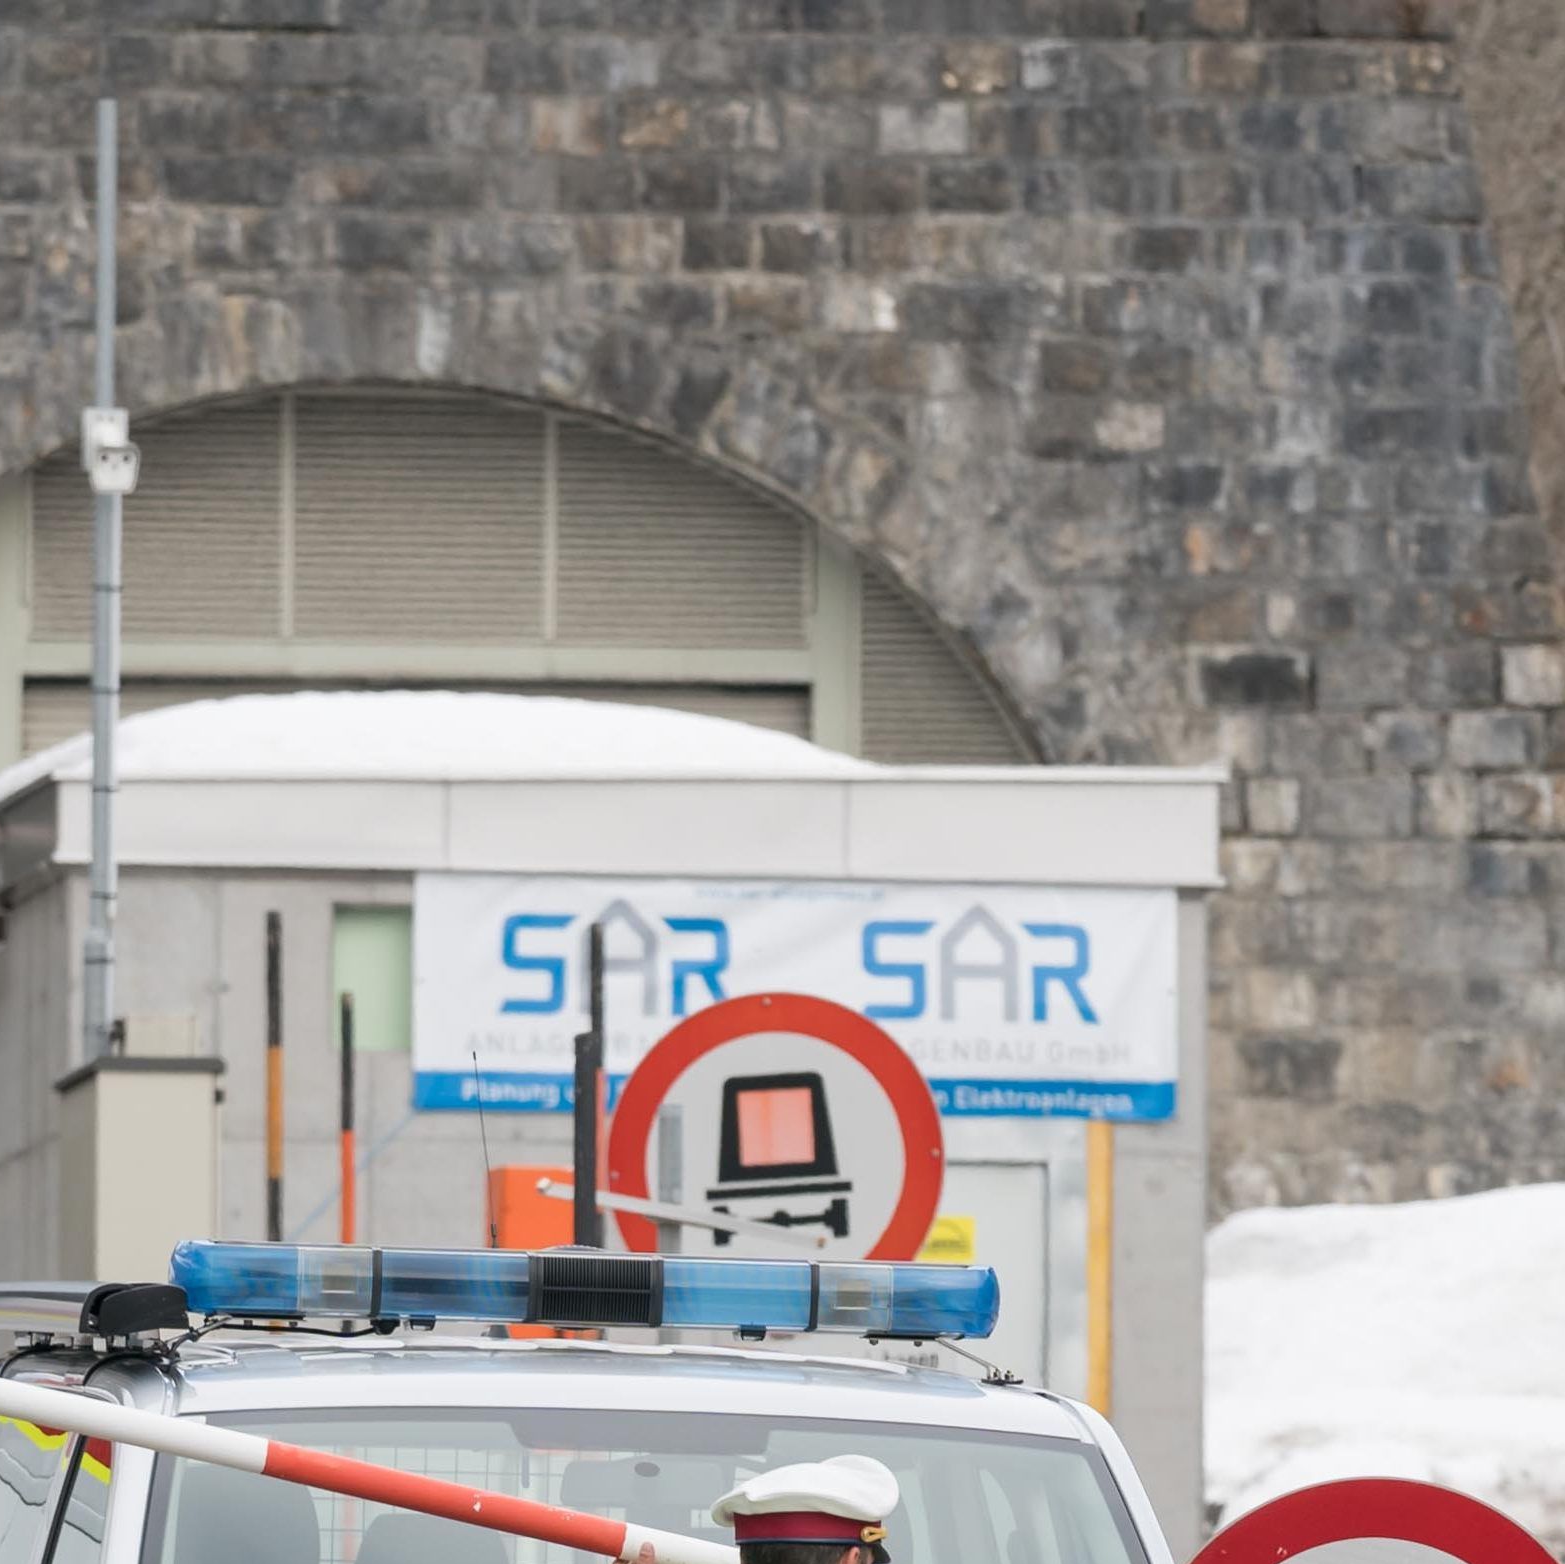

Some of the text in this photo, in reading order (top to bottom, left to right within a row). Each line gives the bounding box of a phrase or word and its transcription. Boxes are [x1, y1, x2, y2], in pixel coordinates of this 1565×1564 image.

[499, 898, 1100, 1024] SAR SAR
[461, 1078, 560, 1109] Planung
[953, 1084, 1134, 1117] Elektroanlagen
